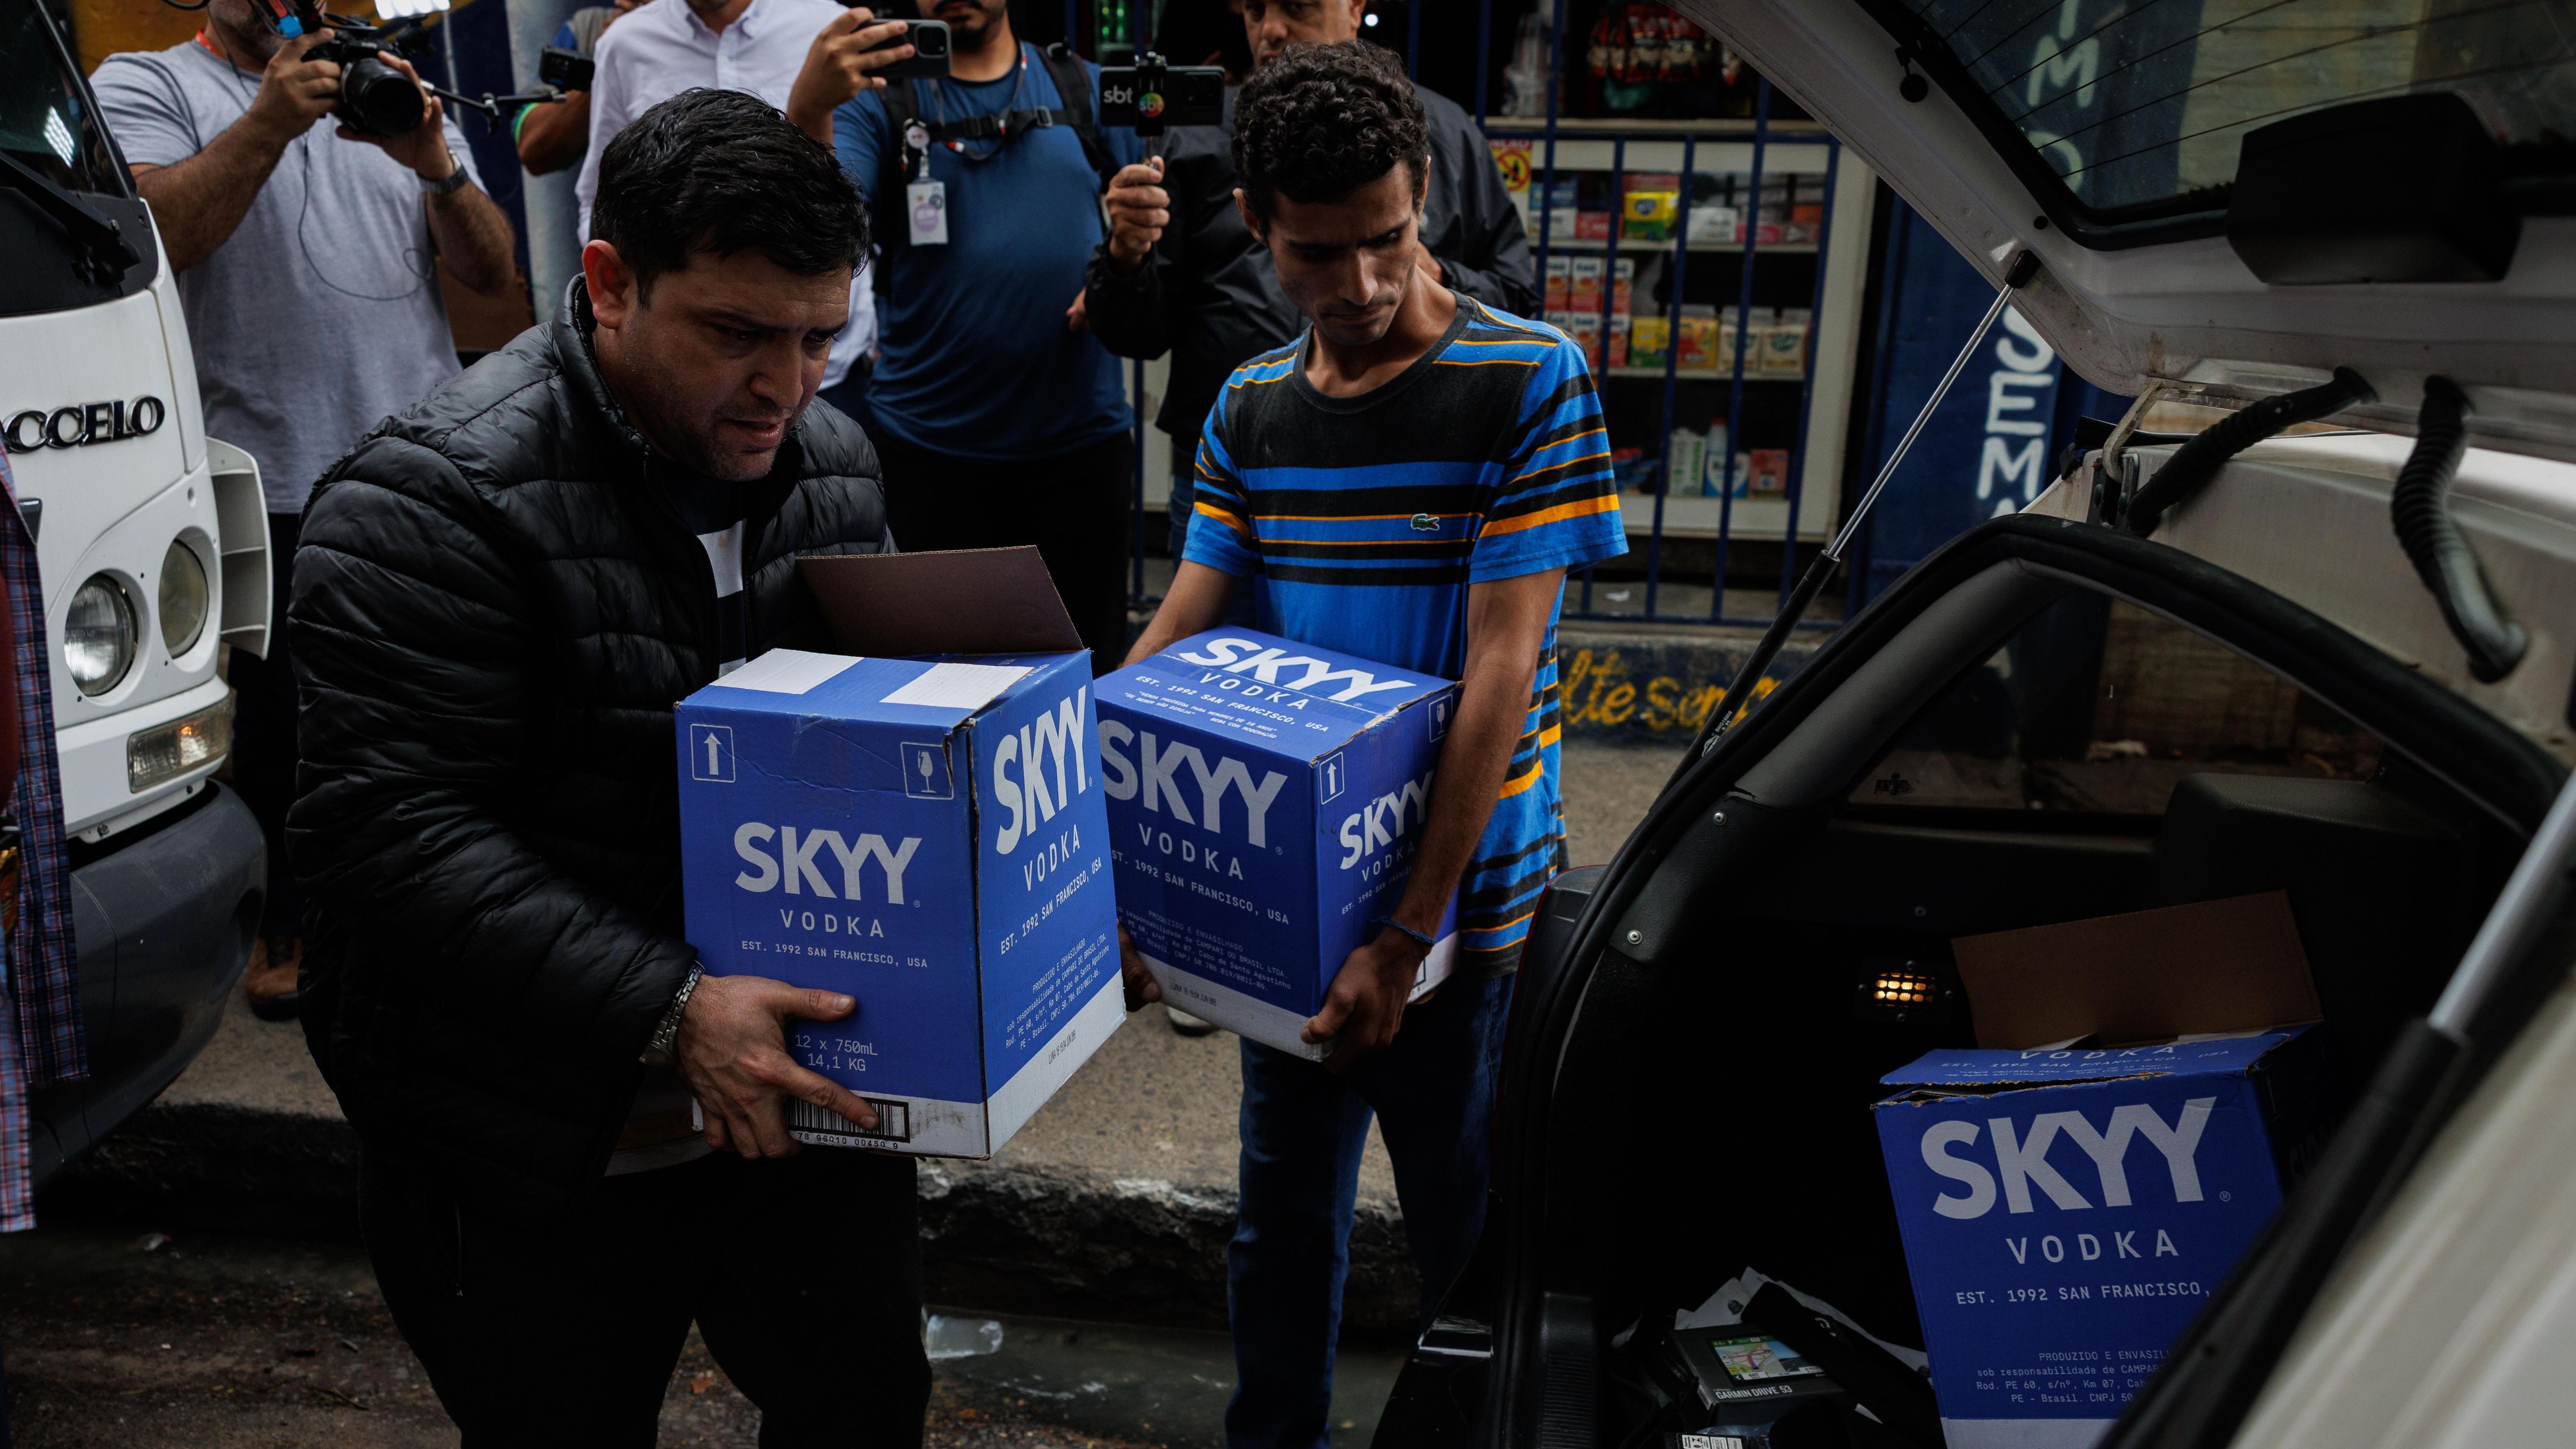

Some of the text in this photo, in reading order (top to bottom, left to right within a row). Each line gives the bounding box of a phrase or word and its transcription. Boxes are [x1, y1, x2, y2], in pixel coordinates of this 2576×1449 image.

[1103, 85, 1133, 104] sbt
[0, 395, 165, 453] CCELO
[1178, 637, 1417, 702] SKYY
[1199, 673, 1309, 710] VODKA
[1559, 649, 1636, 726] lte
[1135, 676, 1329, 732] EST. 1992 SAN FRANCISCO, USA
[1207, 711, 1234, 720] MENORES
[1241, 726, 1277, 739] MODERAÇÃO
[994, 685, 1086, 855] SKYY
[1097, 719, 1288, 849] SKYY
[1340, 769, 1436, 869] SKYY
[734, 822, 922, 905] SKYY
[1024, 824, 1081, 892] VODKA
[1138, 823, 1243, 881] VODKA
[1362, 841, 1415, 882] VODKA
[1001, 857, 1101, 955] EST. 1992 SAN FRANCISCO, USA
[1111, 849, 1289, 925] ST. 1992 SAN FRANCISCO, USA
[1342, 865, 1412, 915] EST. 1992 SAN FRANCIS
[780, 909, 884, 938] VODKA
[1126, 911, 1181, 939] responsabilidade
[1196, 939, 1224, 955] CAMPARI
[1227, 951, 1236, 959] DO
[1239, 955, 1264, 970] BRASIL
[1267, 966, 1288, 978] LTDA.
[1148, 910, 1184, 930] PRODUZIDO
[1196, 929, 1243, 952] ENVASILHADO
[742, 941, 928, 968] EST. 1992 SAN FRANCISCO, USA
[1033, 938, 1085, 994] PRODUZIDO E ENVASILHADO
[1172, 939, 1180, 948] Km
[1199, 950, 1215, 962] Cabo
[1230, 962, 1250, 975] Santo
[1254, 971, 1291, 989] Agostinho
[1174, 950, 1190, 962] CNPJ
[1006, 1035, 1016, 1049] Rod.
[1018, 1027, 1024, 1037] PE
[1049, 999, 1054, 1008] Km
[1064, 980, 1073, 994] Cabo
[1074, 974, 1079, 983] de
[1080, 963, 1091, 977] Santo
[1092, 945, 1109, 966] Agostinho
[1017, 984, 1054, 1024] responsabilidade
[1056, 977, 1061, 987] de
[1062, 962, 1077, 981] CAMPARI
[1078, 955, 1083, 965] DO
[1084, 944, 1096, 959] BRASIL
[1097, 933, 1107, 947] LTDA.
[1021, 1038, 1026, 1050] PE
[1033, 1020, 1049, 1038] Brasil.
[1051, 1008, 1060, 1021] CNPJ
[1062, 969, 1100, 1010] 50.706.019/0011-06.
[795, 1035, 878, 1055] 12 x 750mL
[808, 1054, 866, 1072] 14,1 KG
[2021, 1046, 2174, 1059] VODKA
[816, 1135, 847, 1144] 96010
[855, 1139, 885, 1147] 00450
[1921, 1096, 2217, 1219] SKYY
[2006, 1229, 2179, 1264] VODKA
[1956, 1282, 2210, 1304] EST. 1992 SAN FRANCISCO,
[1978, 1365, 2159, 1377] sob responsabilidade de CAMPAR
[2039, 1350, 2172, 1361] PRODUZIDO E ENVASIL
[1716, 1385, 1793, 1399] GARMIN DRIVE 53
[1977, 1381, 1999, 1390] Rod.
[2006, 1380, 2018, 1390] PE
[2024, 1380, 2041, 1391] 60,
[2084, 1379, 2096, 1388] Km
[2102, 1379, 2120, 1389] 07,
[2127, 1379, 2146, 1388] Cab
[2012, 1394, 2024, 1403] PE
[2042, 1393, 2083, 1403] Brasil.
[2089, 1393, 2115, 1403] CNPJ
